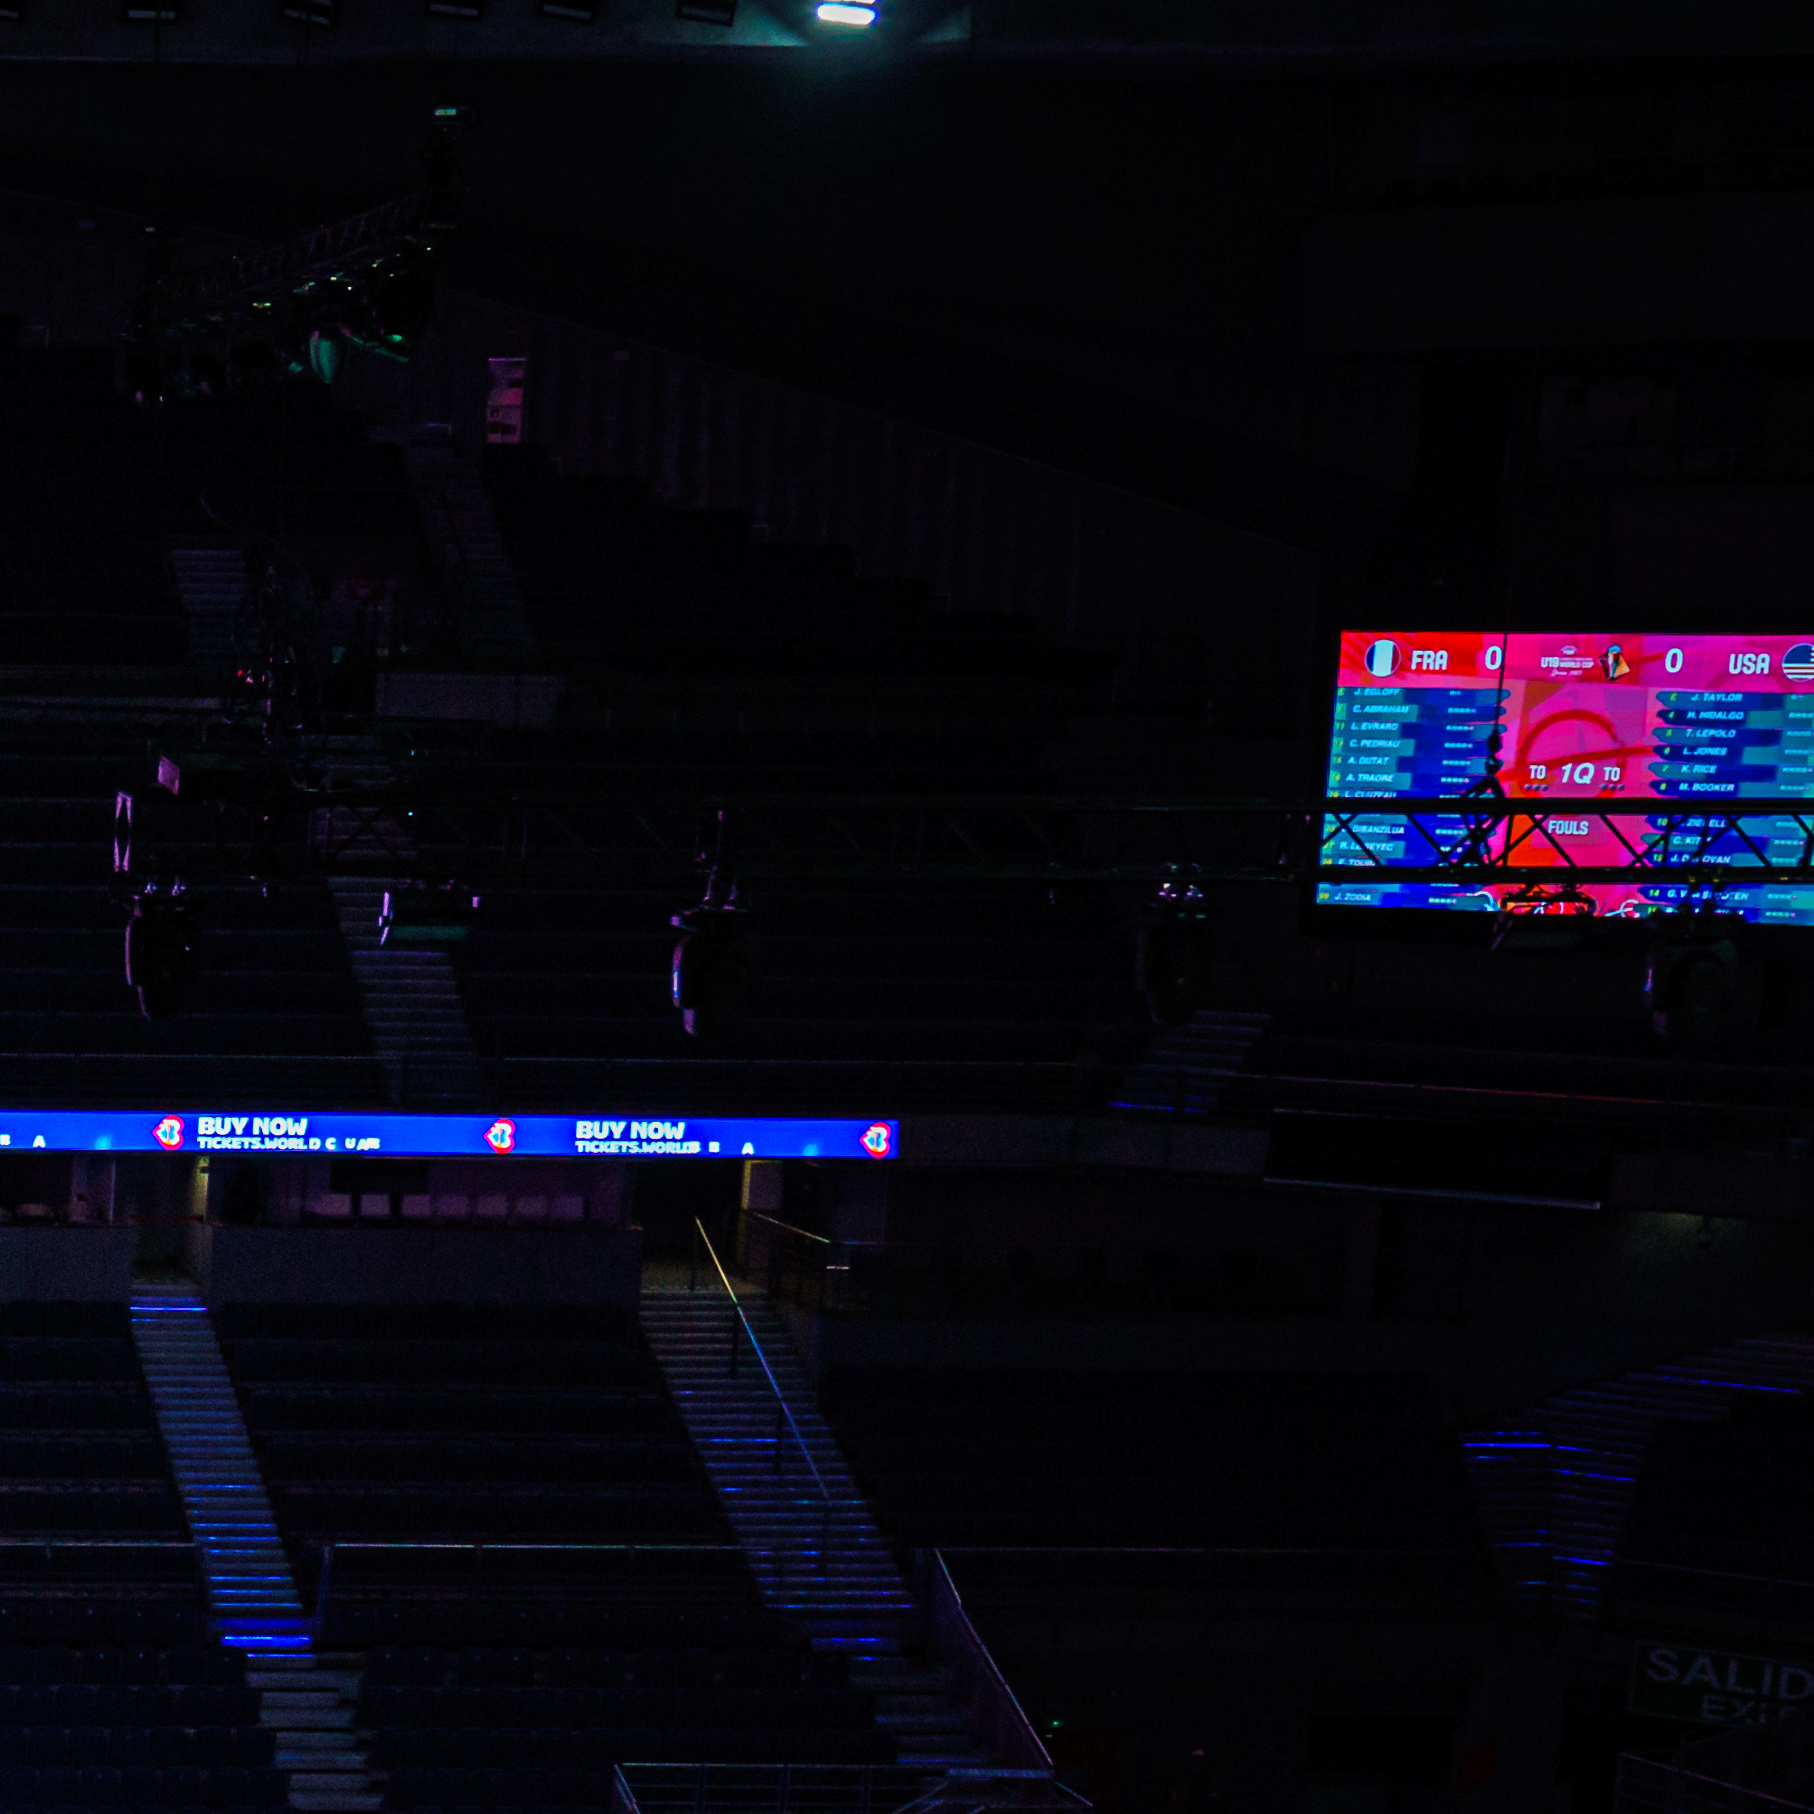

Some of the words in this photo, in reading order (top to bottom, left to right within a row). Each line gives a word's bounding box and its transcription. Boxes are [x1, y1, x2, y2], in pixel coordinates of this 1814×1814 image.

[1411, 651, 1448, 670] FRA
[1485, 646, 1502, 670] 0
[1541, 657, 1559, 668] U19
[1665, 648, 1683, 672] 0
[1729, 654, 1770, 674] USA
[1530, 765, 1546, 779] TO
[1561, 762, 1595, 784] 1Q
[1604, 767, 1621, 782] TO
[1548, 820, 1589, 835] FOULS
[198, 1117, 248, 1136] BUY
[253, 1117, 308, 1136] NOW
[575, 1121, 627, 1139] BUY
[630, 1121, 686, 1139] NOW
[1646, 1649, 1814, 1700] SALID
